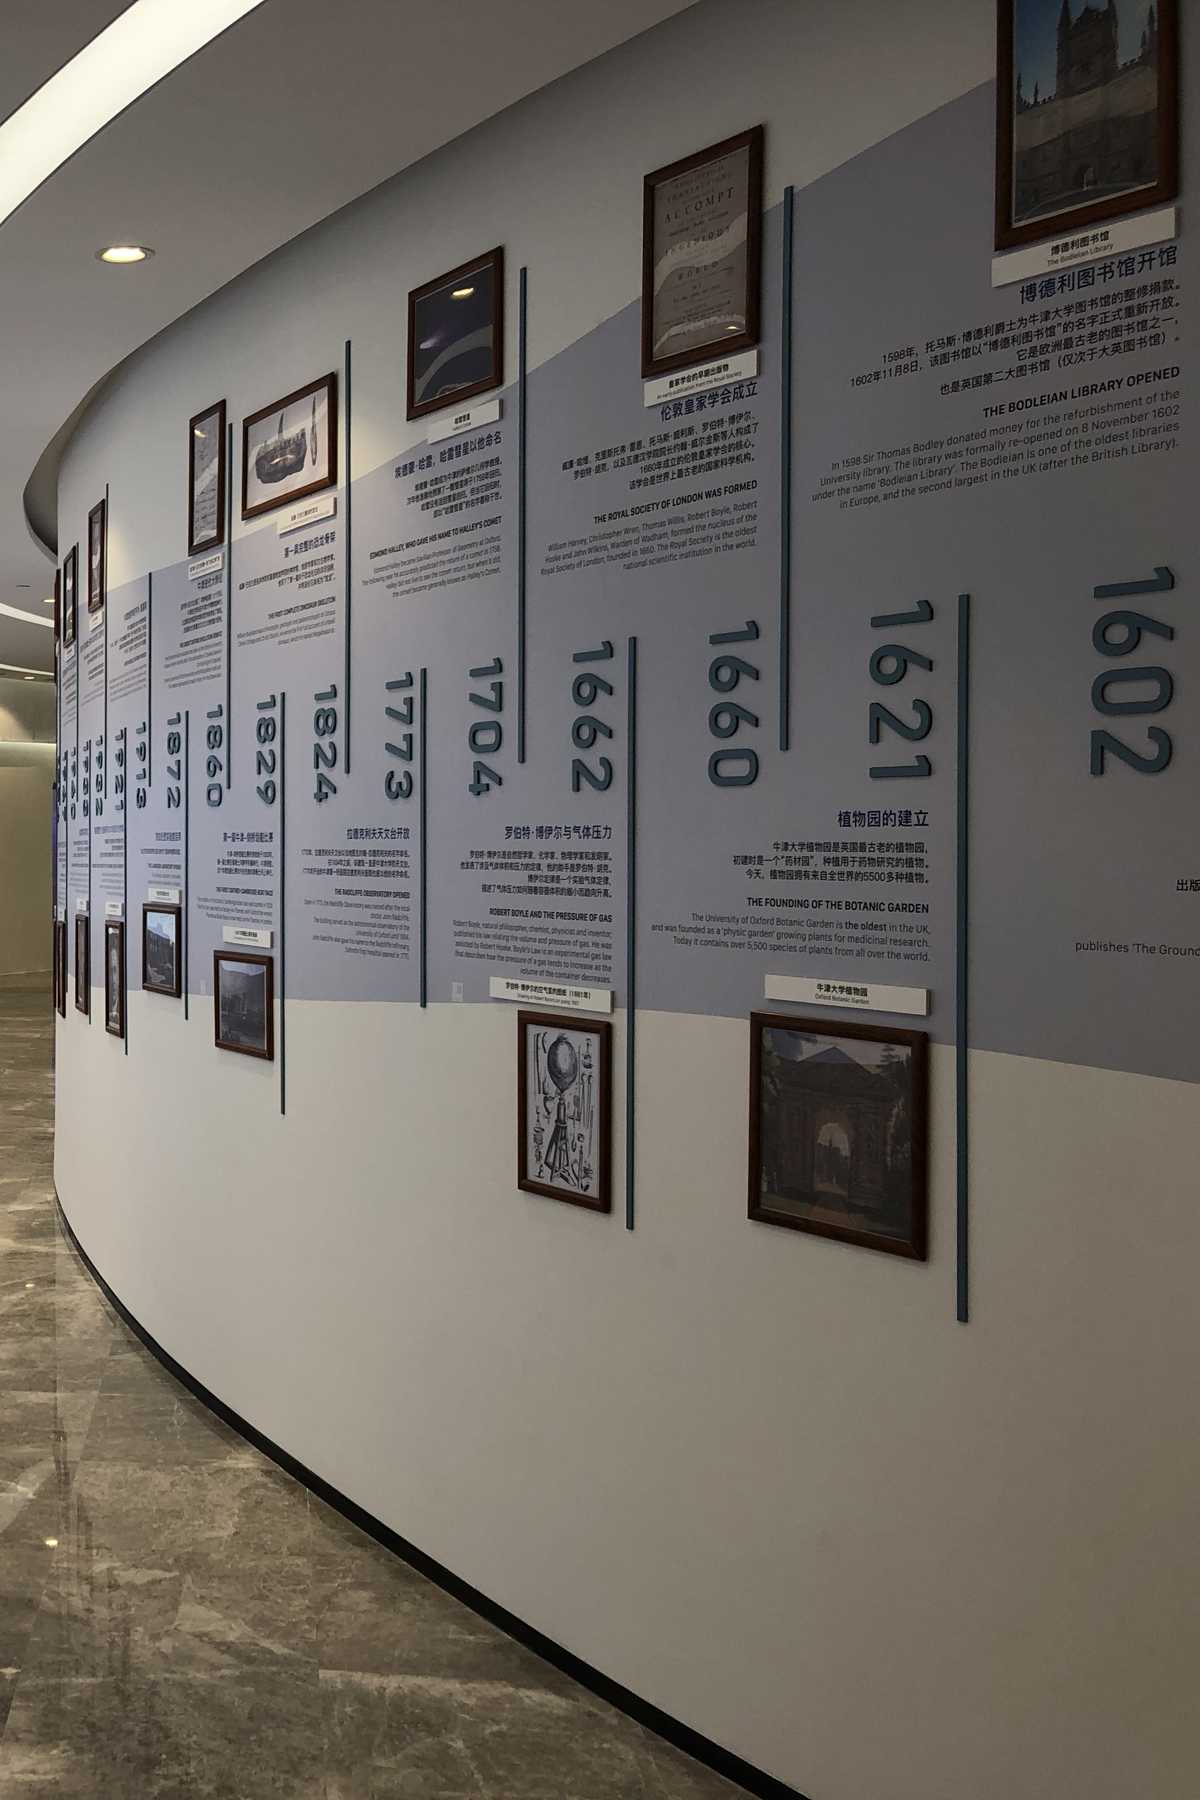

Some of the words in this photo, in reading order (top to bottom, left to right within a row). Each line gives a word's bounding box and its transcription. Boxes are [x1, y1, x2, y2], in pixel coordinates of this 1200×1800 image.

[1019, 246, 1178, 302] 博德利图书馆开馆
[1050, 231, 1110, 255] 博德利图书馆
[660, 382, 758, 421] 伦敦皇家学会成立
[984, 404, 1005, 418] THE
[1008, 391, 1068, 412] BODLEIAN
[1071, 379, 1123, 399] LIBRARY
[1127, 367, 1180, 387] OPENED
[820, 472, 861, 486] University
[895, 460, 911, 471] The
[912, 455, 943, 467] library
[944, 450, 964, 461] was
[965, 440, 1006, 456] formally
[1008, 428, 1063, 447] re-opened
[1065, 426, 1079, 436] on
[1082, 422, 1089, 433] 8
[1091, 412, 1149, 430] November
[1153, 404, 1180, 418] 1602
[832, 462, 840, 471] In
[863, 454, 874, 464] Sir
[877, 447, 911, 460] Thomas
[913, 440, 944, 453] Bodley
[946, 428, 987, 446] donated
[989, 424, 1023, 437] money
[1026, 419, 1041, 430] for
[1043, 415, 1061, 426] the
[1063, 397, 1143, 421] refurbishment
[1145, 392, 1157, 405] of
[1160, 390, 1180, 402] the
[812, 489, 835, 502] under
[837, 487, 851, 496] the
[852, 482, 876, 493] name
[961, 461, 979, 472] The
[980, 452, 1024, 468] Bodleian
[1027, 448, 1036, 459] is
[1038, 446, 1058, 457] one
[1060, 440, 1071, 453] of
[1074, 439, 1092, 450] the
[1095, 431, 1129, 446] oldest
[1132, 423, 1180, 438] libraries
[840, 500, 848, 509] in
[883, 488, 900, 501] and
[901, 488, 916, 497] the
[918, 479, 952, 494] second
[954, 473, 988, 487] largest
[991, 470, 1000, 480] in
[1002, 467, 1019, 478] the
[1022, 463, 1037, 475] UK
[1039, 459, 1067, 472] (after
[1071, 455, 1089, 466] the
[1091, 447, 1128, 462] British
[594, 514, 607, 524] THE
[608, 509, 628, 521] ROYAL
[630, 502, 660, 516] SOCIETY
[661, 499, 671, 509] OF
[672, 492, 703, 507] LONDON
[705, 488, 722, 499] WAS
[724, 480, 758, 495] FORMED
[869, 599, 934, 778] 1621
[1090, 566, 1175, 776] 1602
[469, 657, 503, 796] 1704
[572, 640, 614, 792] 1662
[708, 619, 760, 786] 1660
[136, 721, 147, 809] 1913
[166, 712, 181, 809] 1872
[206, 704, 223, 808] 1860
[256, 694, 277, 806] 1829
[313, 683, 337, 803] 1824
[384, 671, 413, 800] 1773
[504, 825, 612, 840] 罗伯特·博伊尔与气体压力
[837, 810, 929, 827] 植物园的建立
[489, 908, 510, 916] ROBERT
[511, 909, 529, 918] BOYLE
[530, 910, 543, 919] AND
[543, 911, 555, 920] THE
[555, 912, 588, 921] PRESSURE
[589, 913, 598, 922] OF
[599, 914, 613, 923] GAS
[651, 924, 664, 932] and
[678, 924, 706, 934] founded
[776, 931, 807, 942] growing
[808, 932, 833, 942] plants
[834, 933, 845, 944] for
[847, 935, 888, 945] medicinal
[692, 913, 704, 922] The
[705, 914, 740, 926] University
[741, 916, 749, 924] of
[749, 916, 775, 926] Oxford
[776, 917, 805, 927] Botanic
[806, 919, 835, 928] Garden
[836, 920, 843, 930] is
[845, 920, 859, 930] the
[860, 921, 887, 932] oldest
[889, 923, 898, 932] in
[899, 923, 914, 933] the
[748, 897, 763, 907] THE
[764, 898, 810, 909] FOUNDING
[811, 900, 823, 909] OF
[826, 900, 843, 910] THE
[845, 901, 885, 912] BOTANIC
[887, 902, 929, 913] GARDEN
[674, 936, 692, 947] Today
[699, 939, 729, 948] contains
[730, 941, 746, 949] over
[769, 944, 797, 952] species
[798, 945, 807, 953] of
[808, 945, 834, 955] plants
[835, 946, 854, 956] from
[855, 947, 866, 960] all
[867, 950, 885, 959] over
[887, 951, 902, 960] the
[1075, 941, 1129, 953] publishes
[817, 984, 868, 997] 牛津大学植物园
